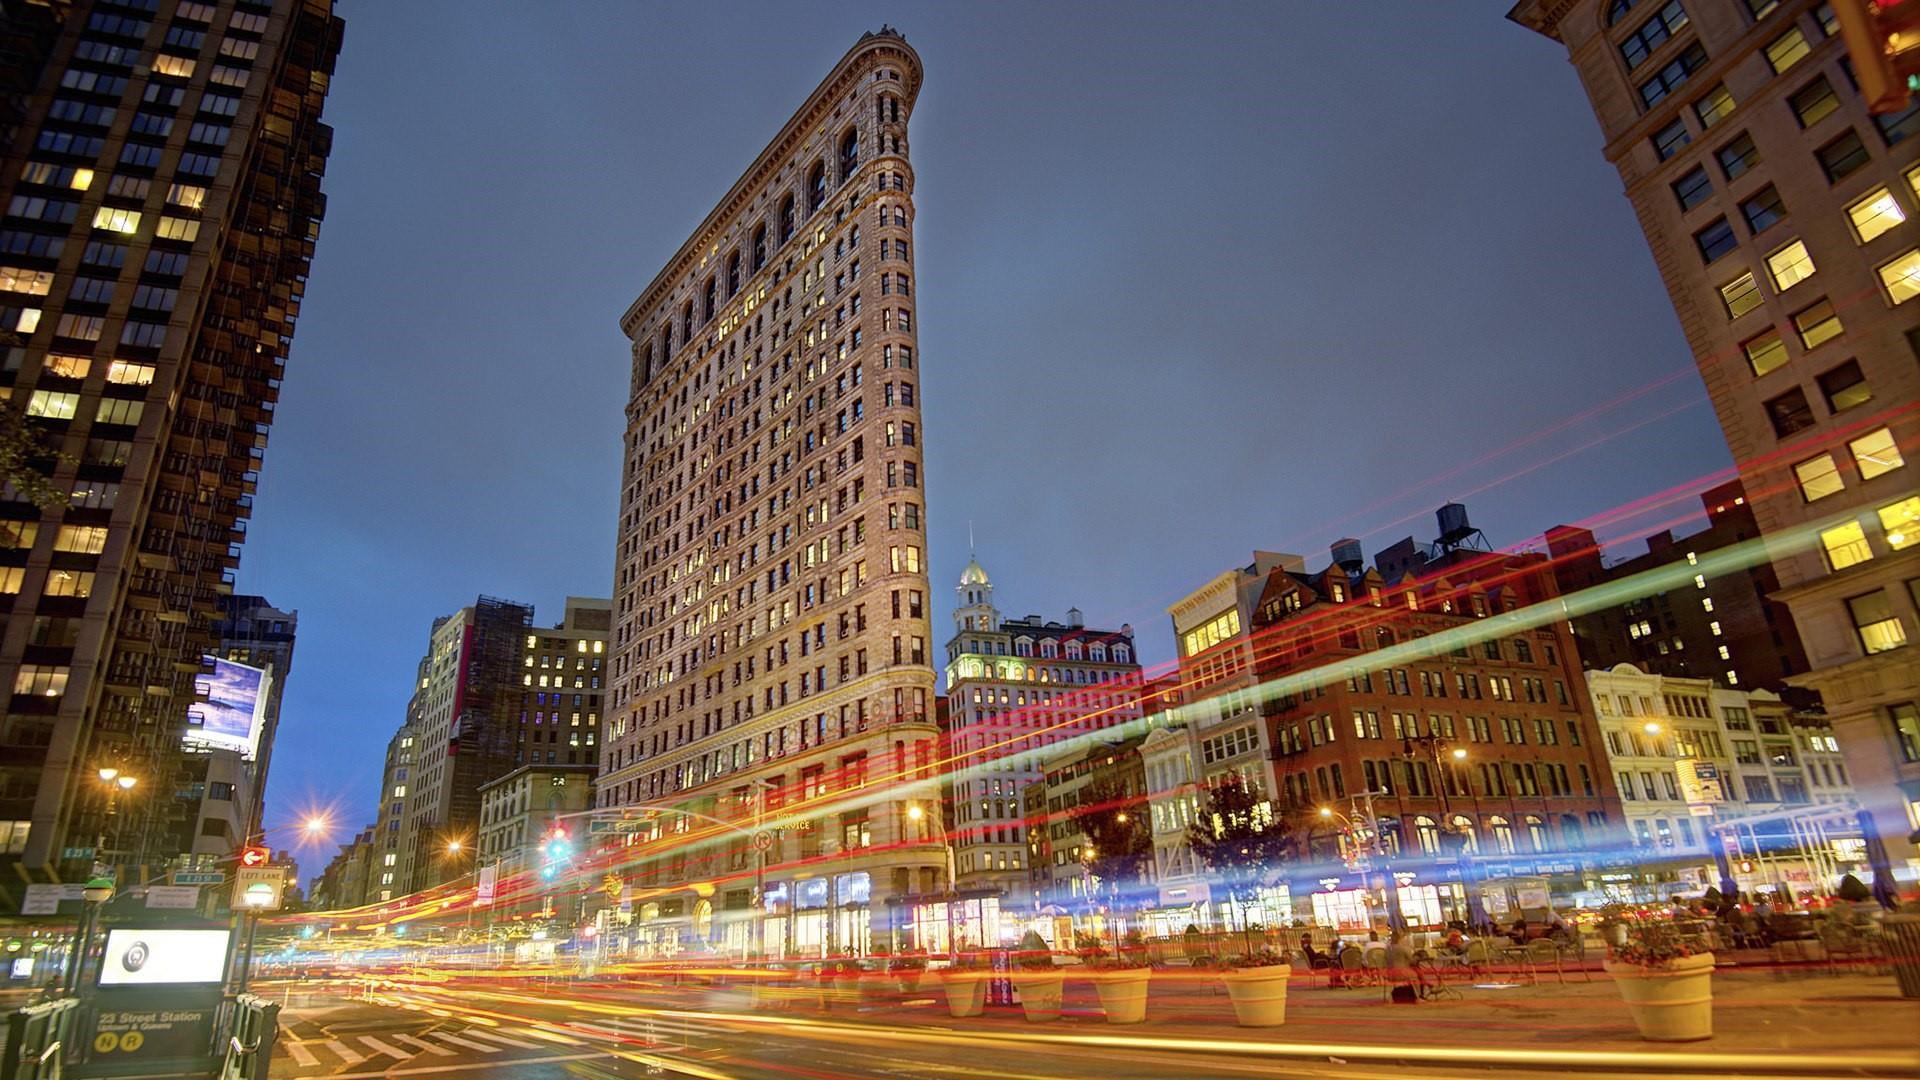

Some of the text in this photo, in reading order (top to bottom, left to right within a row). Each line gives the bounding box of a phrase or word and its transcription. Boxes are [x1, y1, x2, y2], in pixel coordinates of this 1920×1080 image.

[263, 872, 280, 880] LANE
[99, 1010, 202, 1024] 23 Street Station
